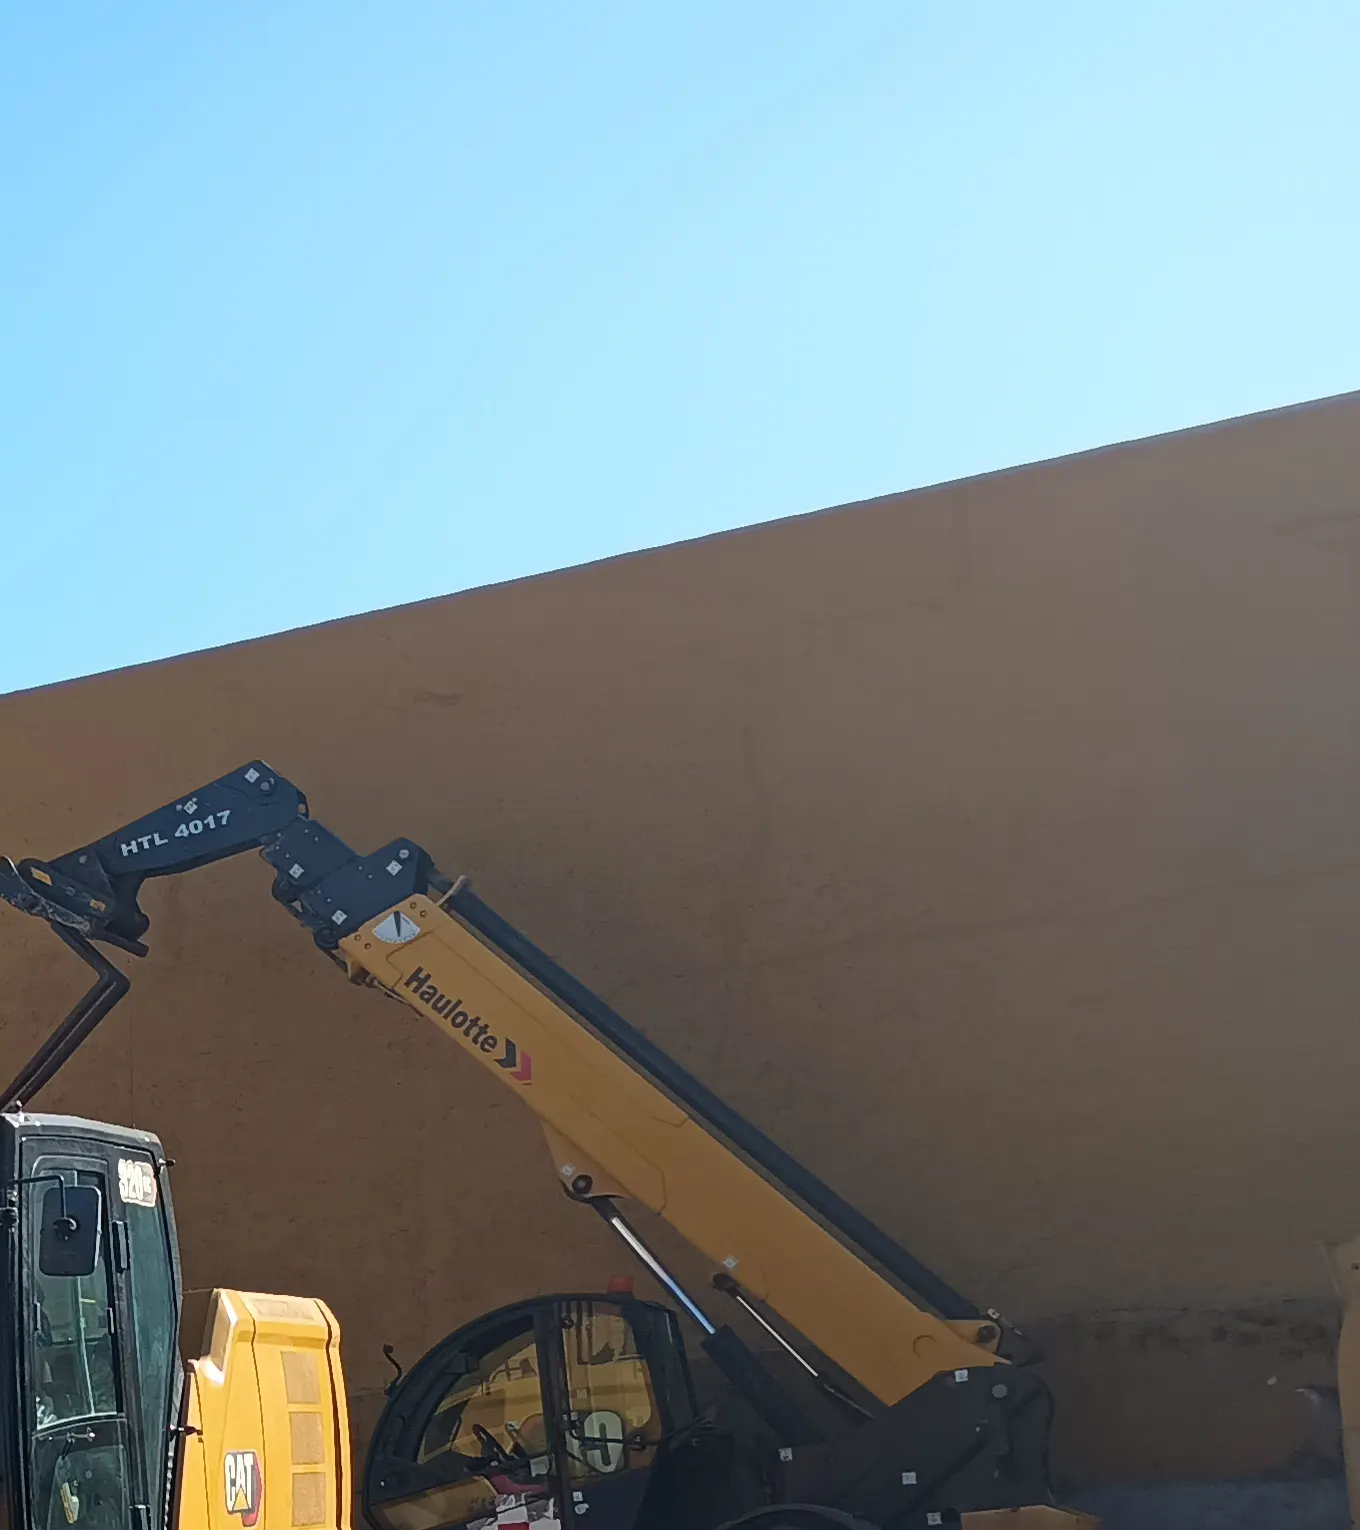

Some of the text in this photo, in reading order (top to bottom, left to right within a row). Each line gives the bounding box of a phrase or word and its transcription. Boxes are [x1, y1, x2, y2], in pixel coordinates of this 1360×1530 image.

[120, 809, 231, 857] HTL 4017
[403, 966, 498, 1053] Haulotte
[224, 1453, 254, 1512] CAT
